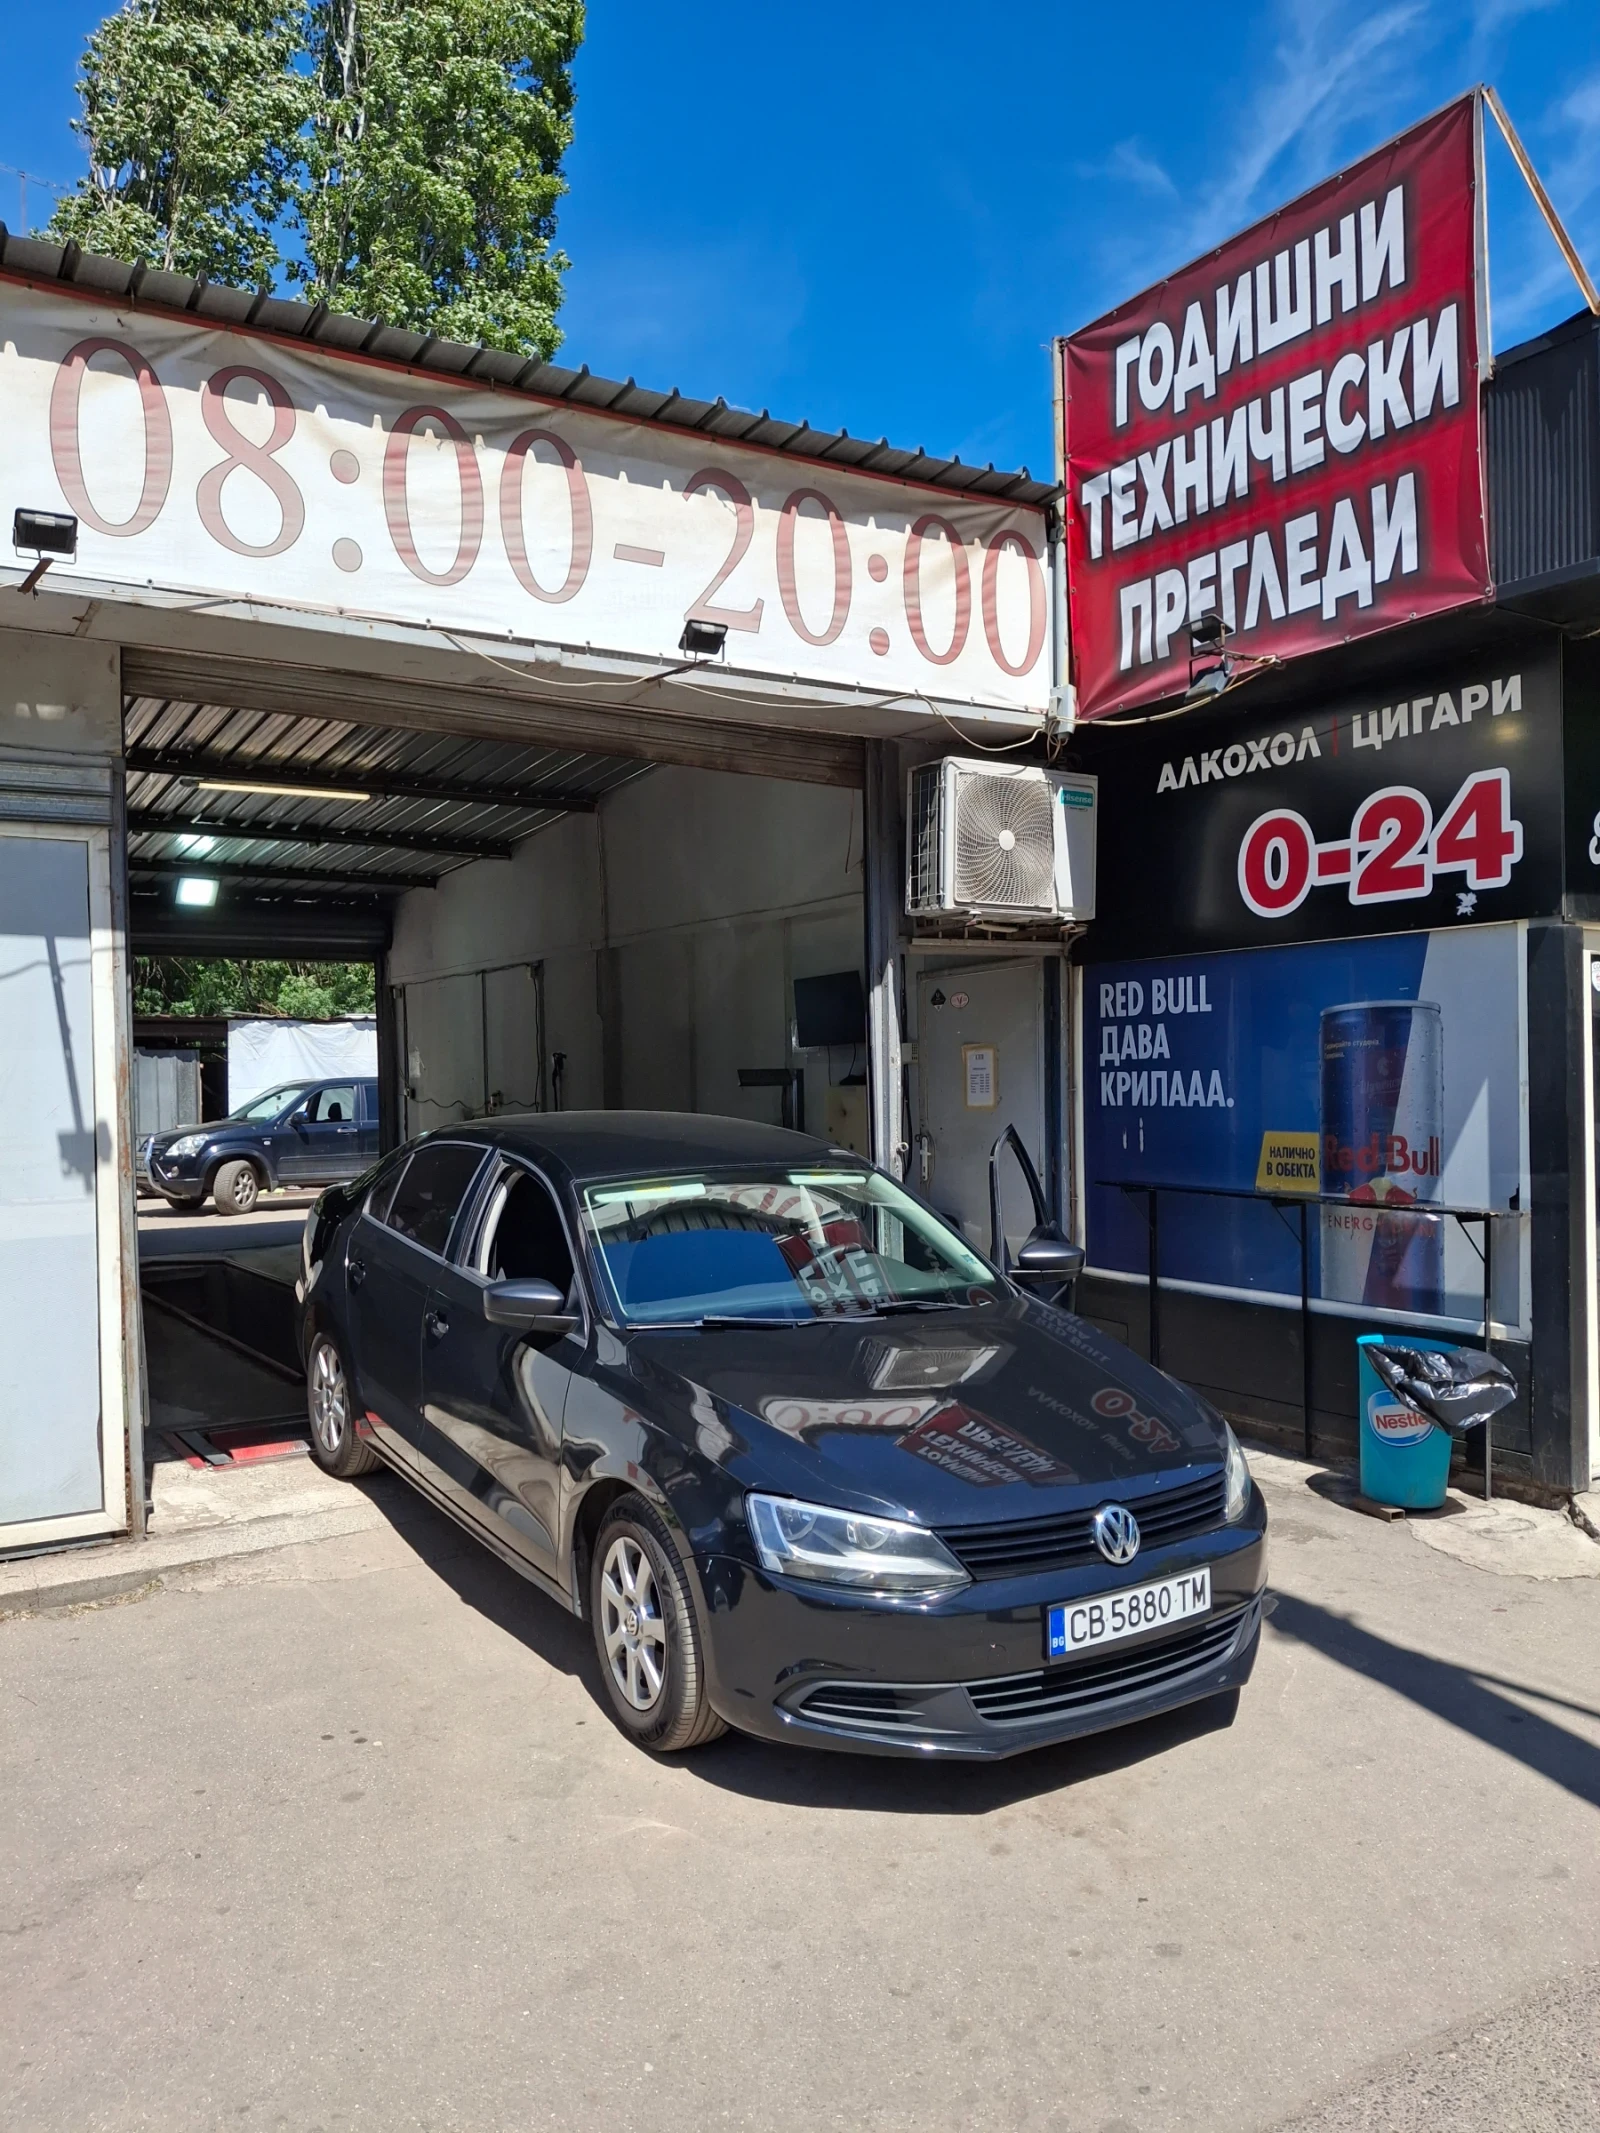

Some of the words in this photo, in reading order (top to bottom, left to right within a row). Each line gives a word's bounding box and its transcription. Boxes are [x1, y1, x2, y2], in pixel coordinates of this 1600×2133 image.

[1115, 184, 1406, 427] ГОДИШНИ
[1081, 303, 1459, 560] ТЕХНИЧЕСКИ
[1120, 472, 1418, 671] ПРЕГЛЕДИ
[1156, 726, 1321, 793] АЛКОХОЛ
[1352, 674, 1522, 750] ЦИГАРИ
[1238, 767, 1523, 918] 0-24
[1100, 981, 1144, 1018] RED
[1152, 975, 1212, 1014] BULL
[1100, 1023, 1170, 1067] ДАВА
[1101, 1070, 1235, 1108] КРИЛААА.
[1267, 1162, 1273, 1176] В
[1276, 1162, 1316, 1178] ОБЕКТА
[1269, 1146, 1316, 1160] НАЛИЧНО
[1324, 1132, 1380, 1173] Red
[1387, 1135, 1439, 1176] Bull
[1111, 1586, 1172, 1632] 5880
[1052, 1636, 1065, 1649] BG
